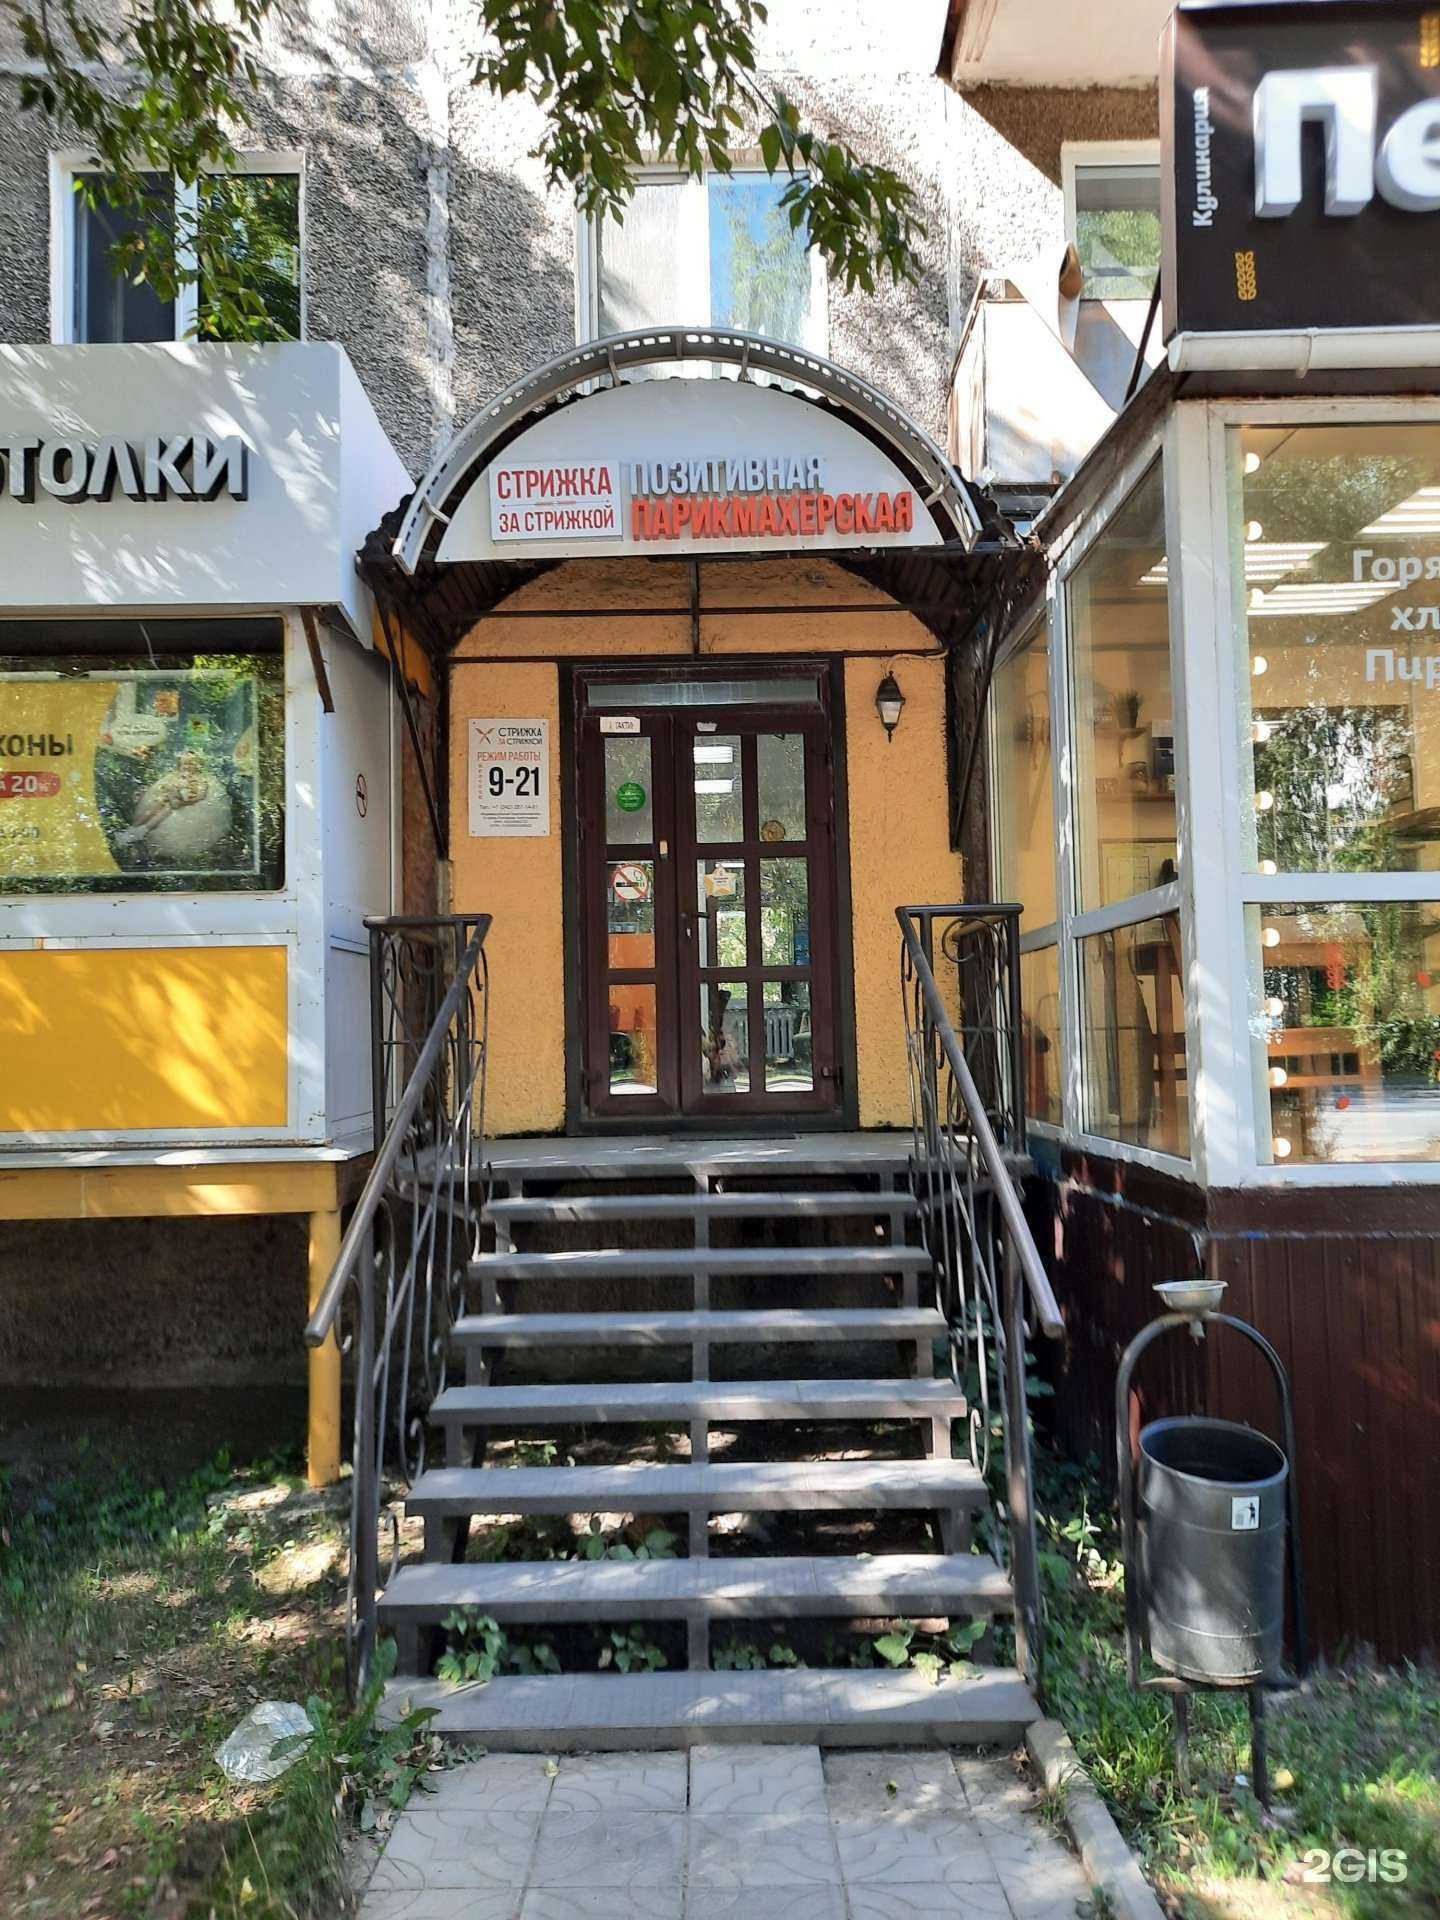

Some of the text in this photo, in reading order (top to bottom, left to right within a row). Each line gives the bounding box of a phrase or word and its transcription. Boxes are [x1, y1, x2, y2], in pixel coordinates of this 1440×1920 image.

[1193, 87, 1218, 227] Кулинария
[1253, 65, 1440, 218] Пе
[0, 434, 249, 503] ТОЛКИ
[497, 467, 613, 499] СТРИЖКА
[631, 456, 827, 497] ПОЗИТИВНАЯ
[499, 505, 614, 533] ЗА СТРИЖКОЙ
[631, 491, 913, 541] ПАРИКМАХЕРСКАЯ
[1352, 549, 1440, 589] Горя
[498, 727, 542, 737] СТРИЖКА
[477, 751, 541, 761] РЕЖИМ РАБОТЫ
[489, 766, 540, 797] 9-21
